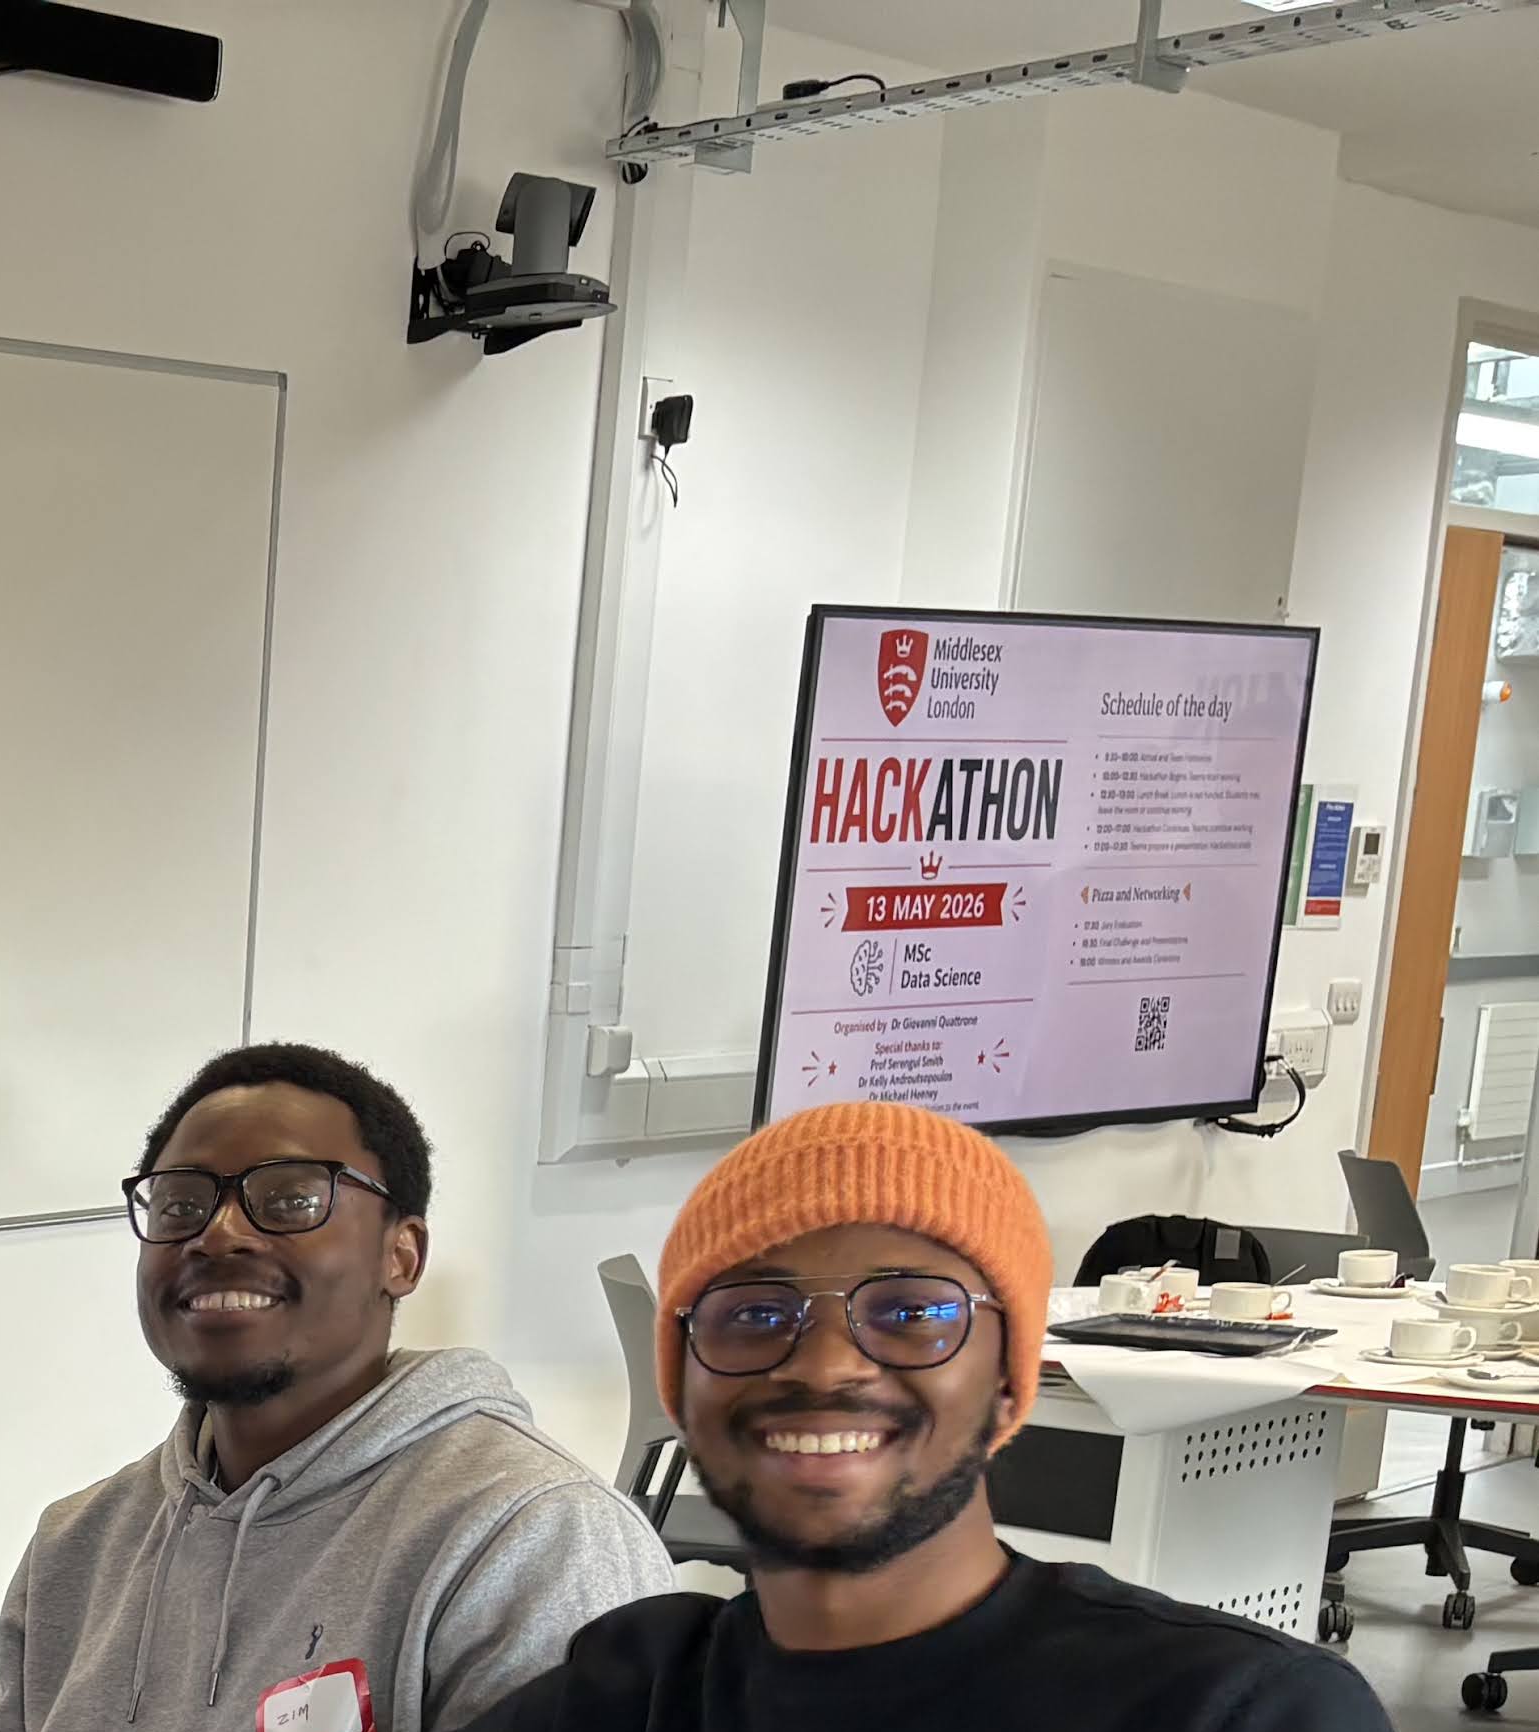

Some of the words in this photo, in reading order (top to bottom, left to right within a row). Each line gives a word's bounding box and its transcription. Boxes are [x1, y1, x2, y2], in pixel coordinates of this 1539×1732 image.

[933, 637, 1003, 663] Middlesex
[930, 667, 999, 697] University
[927, 695, 975, 720] London
[1100, 691, 1164, 717] Schedule
[1166, 693, 1183, 717] of
[1183, 693, 1206, 718] the
[1207, 694, 1233, 724] day
[810, 756, 1063, 844] HACKATHON
[867, 895, 887, 922] 13
[892, 894, 936, 921] MAY
[939, 892, 985, 919] 2026
[904, 943, 932, 963] MSc
[900, 969, 931, 989] Data
[933, 967, 982, 988] Science
